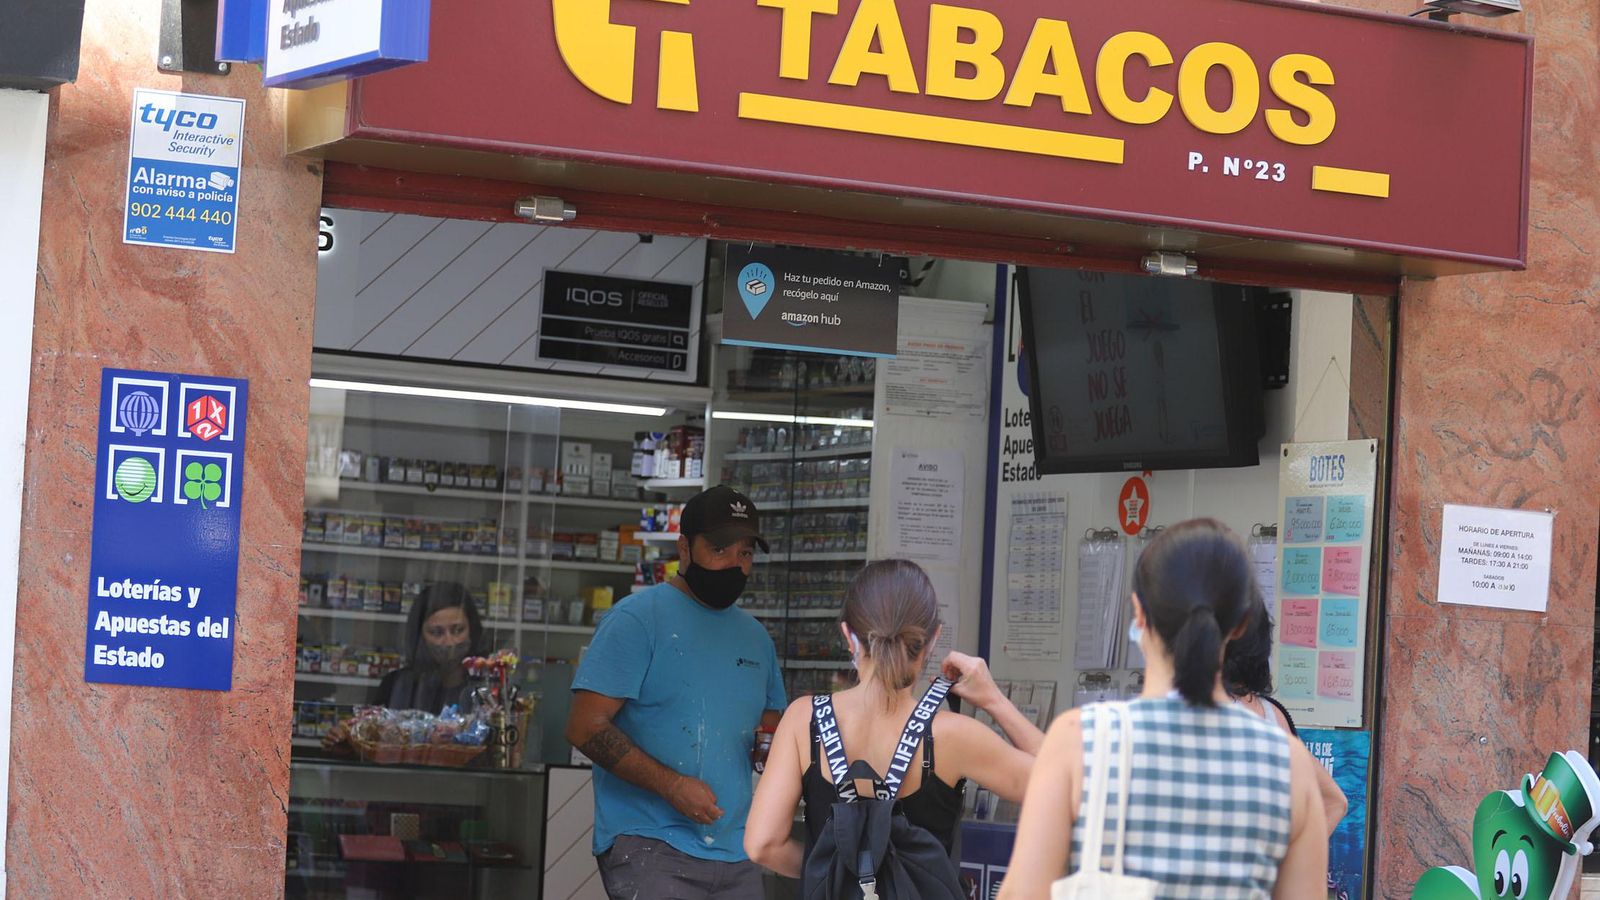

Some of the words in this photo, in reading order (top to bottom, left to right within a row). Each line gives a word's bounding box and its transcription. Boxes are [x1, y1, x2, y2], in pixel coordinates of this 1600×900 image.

[280, 15, 320, 51] Estado
[756, 0, 1336, 145] TABACOS
[139, 103, 218, 132] tyco
[173, 130, 234, 146] Interactive
[168, 142, 215, 158] Security
[1188, 151, 1209, 173] P.
[133, 166, 207, 190] Alarma
[132, 185, 153, 195] con
[156, 186, 185, 198] aviso
[188, 191, 195, 199] a
[197, 191, 233, 203] policía
[131, 202, 161, 219] 902
[165, 205, 196, 222] 444
[199, 209, 232, 226] 440
[784, 272, 800, 282] Haz
[802, 275, 811, 283] tu
[813, 275, 842, 287] pedido
[843, 280, 854, 288] en
[855, 280, 892, 293] Amazon,
[566, 287, 623, 307] IQOS
[783, 288, 819, 301] recógelo
[820, 291, 839, 302] aquí
[781, 311, 818, 324] amazon
[821, 313, 841, 326] hub
[585, 326, 616, 339] Prueba
[617, 329, 641, 340] IQOS
[642, 332, 667, 343] gratis
[618, 350, 665, 364] Accesorios
[1086, 330, 1126, 364] JUEGO
[1088, 373, 1109, 402] NO
[1114, 366, 1128, 399] SE
[1093, 404, 1132, 442] JUEGA
[1310, 454, 1345, 481] BOTES
[1459, 525, 1489, 535] HORARIO
[1500, 529, 1535, 539] APERTURA
[1461, 557, 1487, 566] TARDES:
[1489, 560, 1506, 568] 17:30
[1493, 550, 1510, 559] 09:00
[1517, 553, 1532, 561] 14:00
[97, 576, 182, 602] Loterías
[187, 586, 201, 609] y
[1472, 580, 1489, 589] 10:00
[95, 611, 191, 637] Apuestas
[197, 616, 229, 639] del
[93, 645, 165, 669] Estado
[816, 705, 842, 757] LIFE'S
[891, 720, 925, 772] LIFE'S
